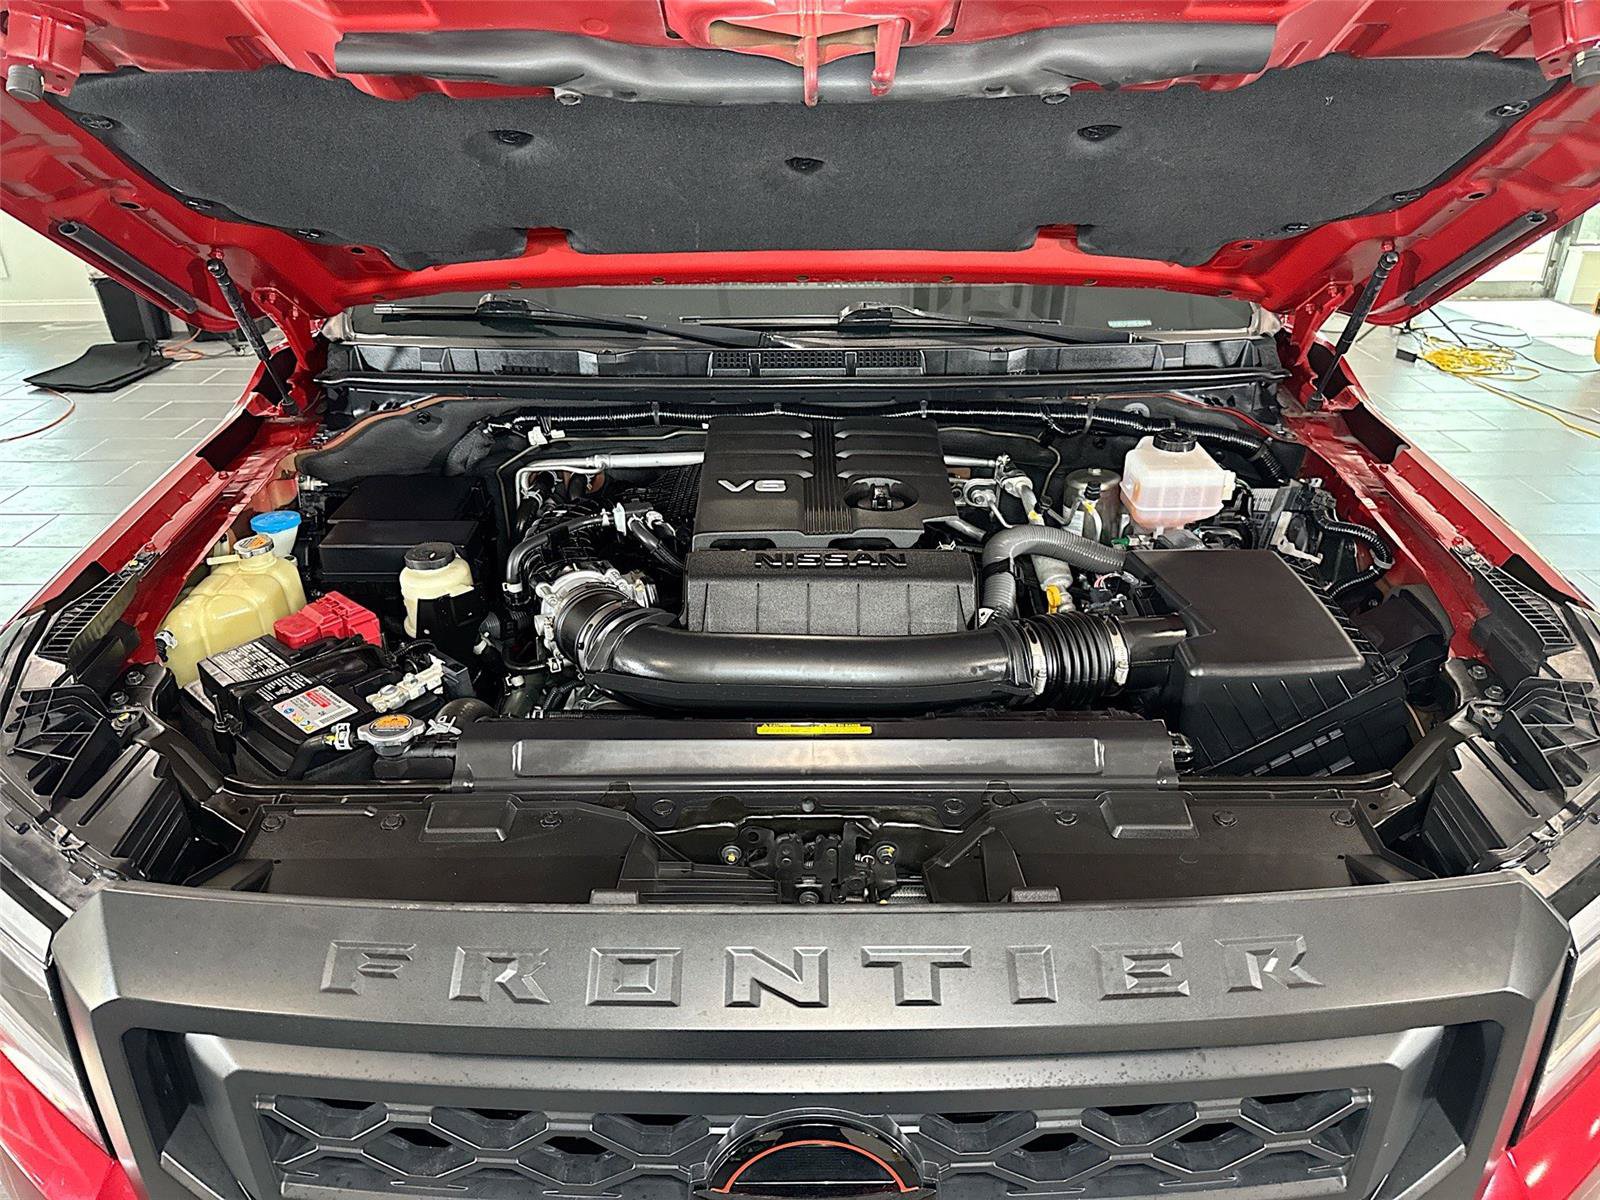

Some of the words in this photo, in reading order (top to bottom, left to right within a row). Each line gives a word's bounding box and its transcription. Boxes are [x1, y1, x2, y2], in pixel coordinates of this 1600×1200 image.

[717, 479, 787, 493] V6
[755, 552, 907, 569] NISSAN
[320, 933, 1326, 1008] FRONTIER
